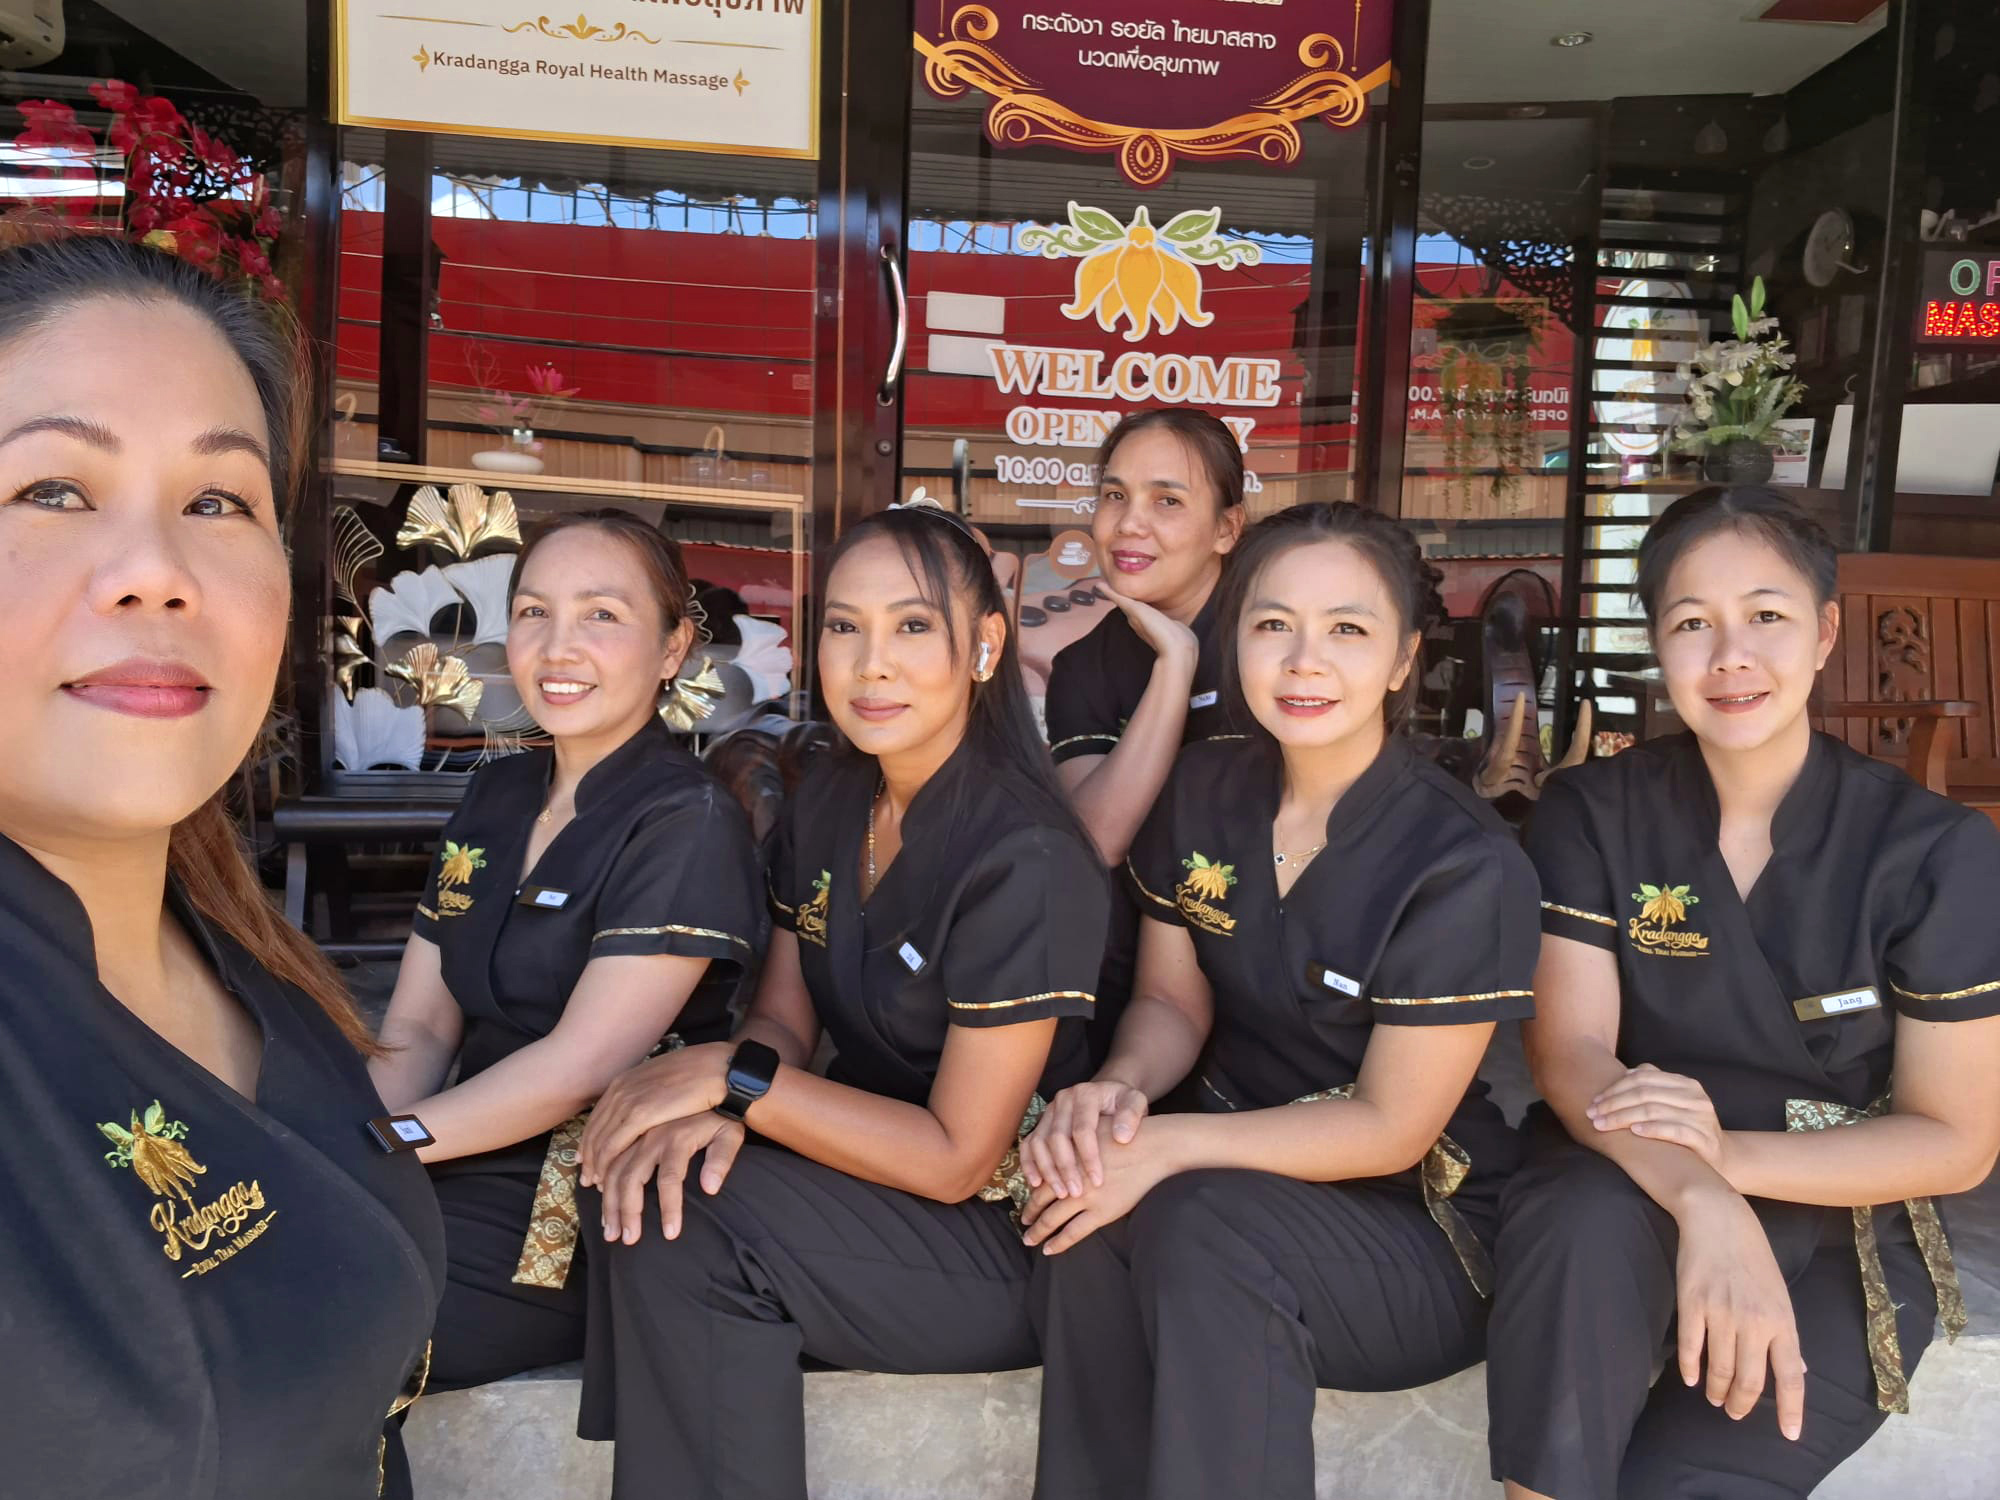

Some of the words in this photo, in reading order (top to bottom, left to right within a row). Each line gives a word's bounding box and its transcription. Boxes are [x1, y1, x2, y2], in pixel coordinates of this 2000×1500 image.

[1022, 12, 1103, 36] กระดังงา
[1110, 20, 1165, 41] รอยัล
[1172, 19, 1277, 50] ไทยมาสสาจ
[433, 51, 530, 76] Kradangga
[536, 60, 584, 79] Royal
[590, 63, 648, 82] Health
[653, 69, 729, 91] Massage
[1078, 46, 1220, 77] นวดเพื่อสุขภาพ
[988, 347, 1279, 404] WELCOME
[996, 457, 1062, 483] 10:00
[1628, 917, 1709, 949] Kradangga
[150, 1179, 266, 1261] Kradangga
